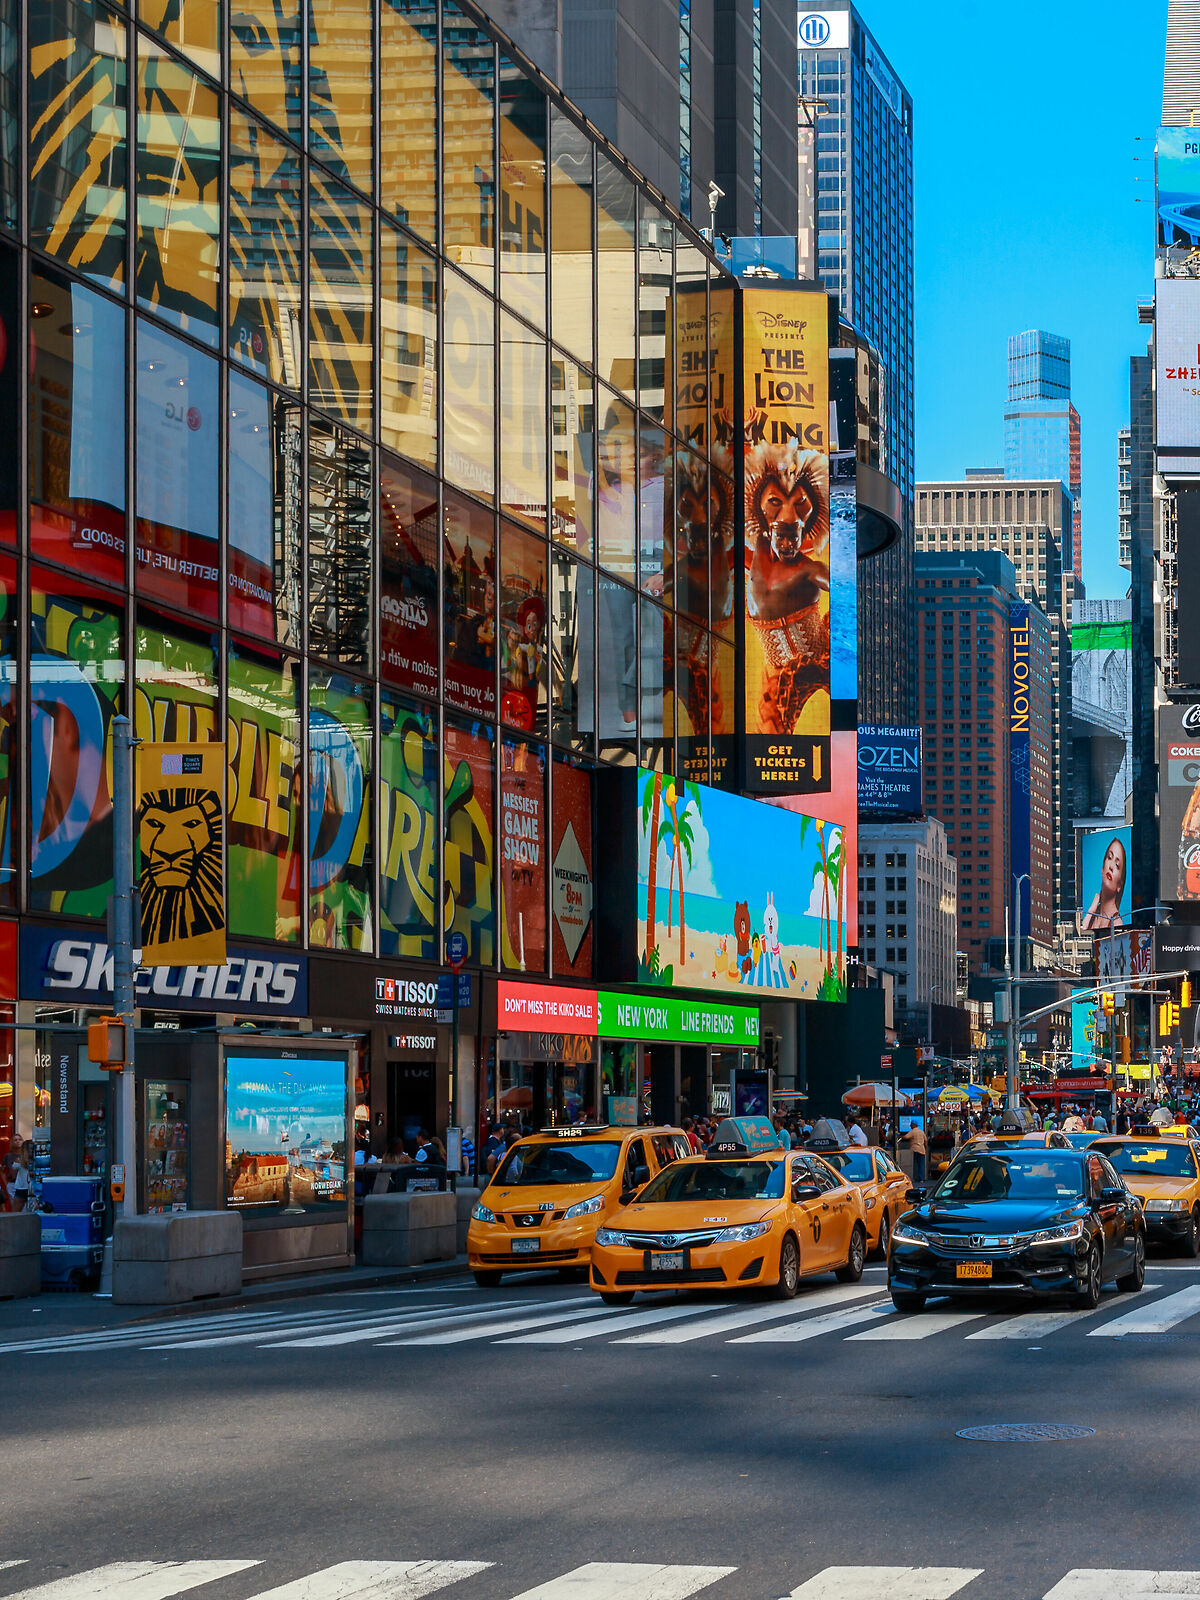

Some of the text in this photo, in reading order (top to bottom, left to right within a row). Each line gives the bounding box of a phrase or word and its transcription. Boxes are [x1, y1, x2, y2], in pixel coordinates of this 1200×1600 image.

[756, 311, 807, 334] Disney
[764, 332, 804, 341] PRESENTS
[761, 348, 805, 370] THE
[754, 372, 814, 408] LION
[752, 411, 823, 447] KING
[1010, 617, 1029, 732] NOVOTEL
[857, 726, 876, 736] OUS
[768, 745, 793, 755] GET
[857, 746, 918, 768] OZEN
[1170, 746, 1200, 757] COKE
[754, 757, 806, 768] TICKETS
[514, 777, 526, 791] THE
[761, 771, 799, 781] HERE!
[881, 784, 910, 793] THEATRE
[503, 791, 539, 815] MESSIEST
[504, 811, 539, 841] GAME
[504, 836, 540, 866] SHOW
[521, 869, 534, 887] TV
[554, 867, 590, 885] WEEKNIGHTS
[566, 883, 583, 906] 8PM
[1162, 944, 1184, 953] Happy
[395, 979, 439, 1004] TISSO
[376, 1003, 393, 1015] SWISS
[393, 1004, 417, 1017] WATCHES
[417, 1006, 433, 1018] SINCE
[504, 998, 527, 1014] DON'T
[527, 999, 544, 1015] MISS
[545, 1001, 558, 1016] THE
[558, 1002, 574, 1017] KIKO
[575, 1004, 593, 1018] SALE!
[617, 1004, 641, 1029] NEW
[643, 1006, 668, 1031] YORK
[681, 1010, 700, 1032] LINE
[701, 1012, 734, 1035] FRIENDS
[405, 1035, 436, 1050] TISSOT
[59, 1054, 70, 1114] Newsstand
[278, 1081, 291, 1094] THE
[557, 1129, 583, 1138] 5H29
[1138, 1126, 1153, 1135] 136
[718, 1142, 736, 1152] 4P55
[310, 1180, 342, 1190] NORWEGIAN
